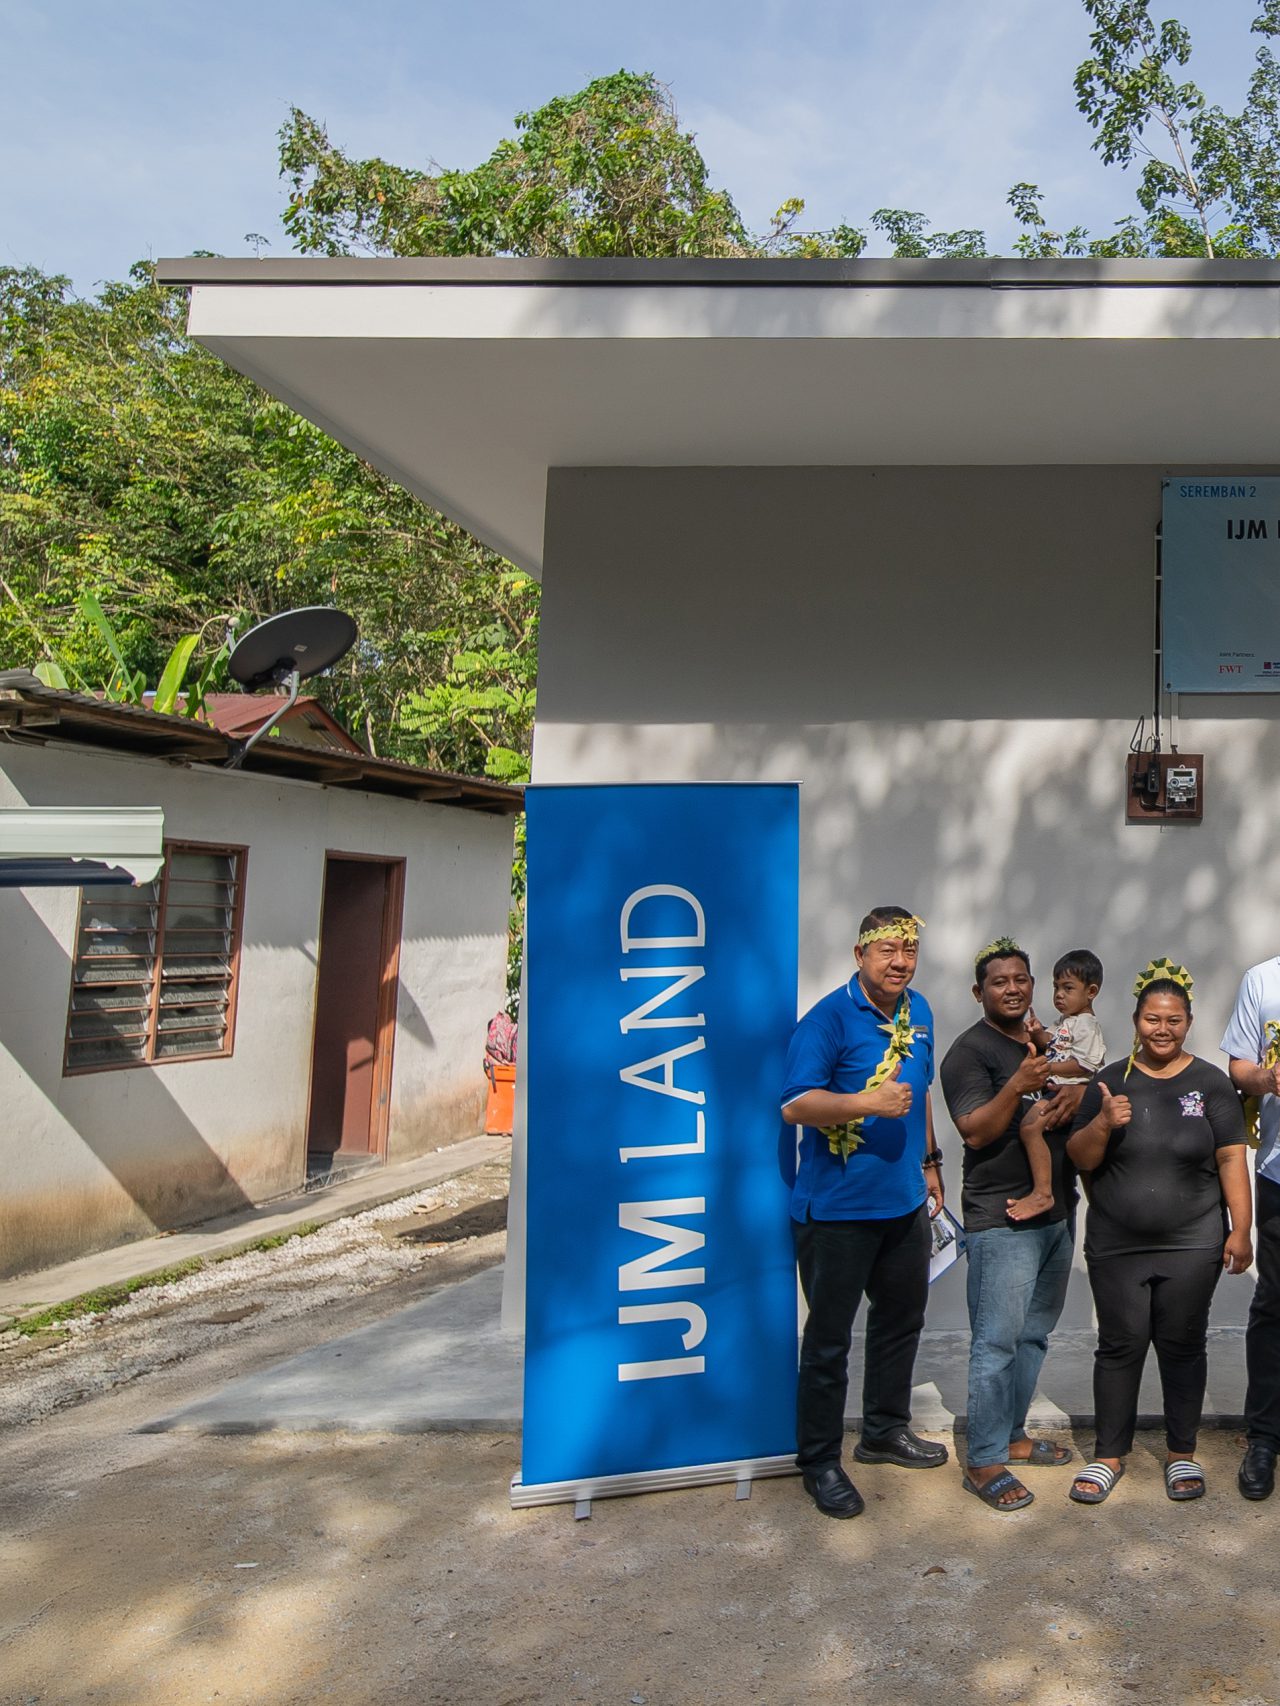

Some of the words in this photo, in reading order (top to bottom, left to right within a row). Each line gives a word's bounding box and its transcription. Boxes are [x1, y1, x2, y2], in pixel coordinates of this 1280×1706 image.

[1179, 485, 1246, 498] SEREMBAN
[1248, 485, 1257, 498] 2
[1226, 519, 1268, 541] IJM
[1218, 664, 1244, 675] FWT
[619, 884, 707, 1163] LAND
[618, 1196, 708, 1382] IJM
